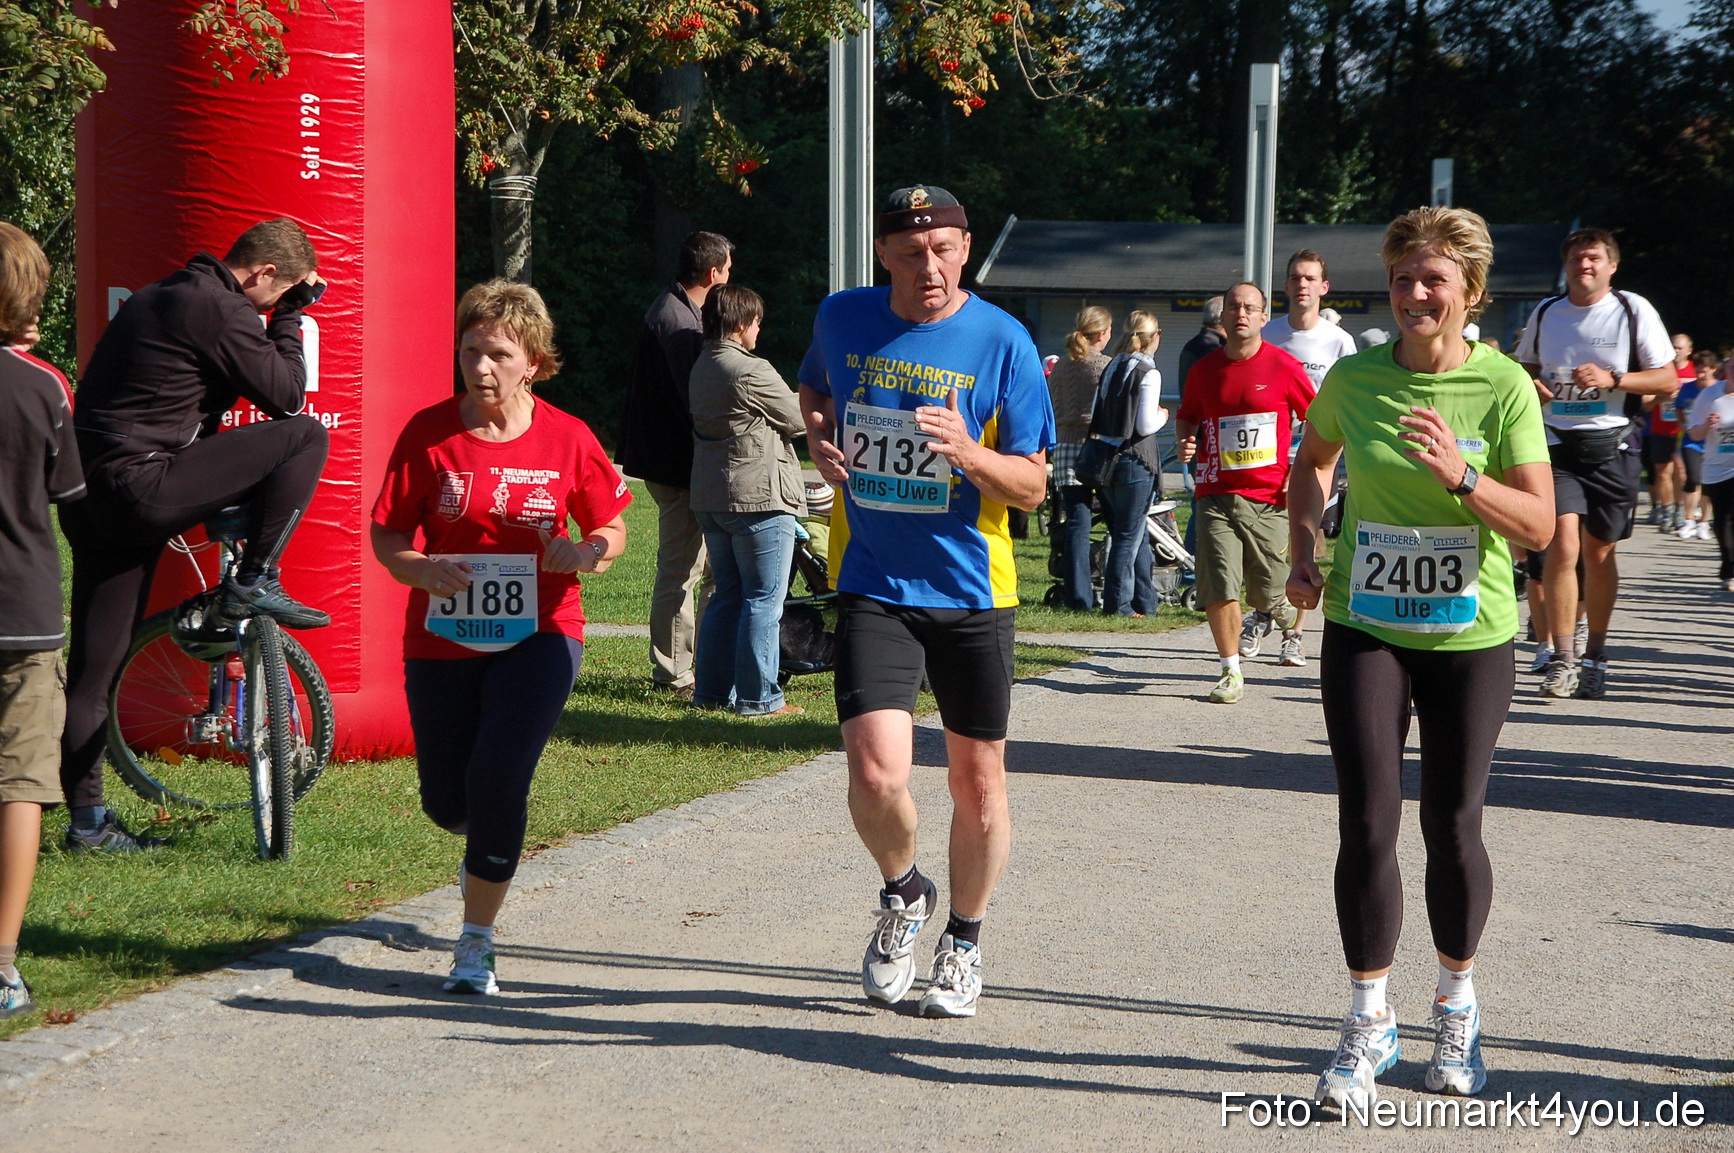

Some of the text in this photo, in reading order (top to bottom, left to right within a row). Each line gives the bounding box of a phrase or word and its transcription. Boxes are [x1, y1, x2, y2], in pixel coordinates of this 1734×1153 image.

[300, 93, 320, 179] Seit 1929
[846, 354, 976, 389] 10. NEUMARKTER
[858, 371, 950, 400] STADTLAUF
[857, 413, 904, 428] PFLEIDERER
[1237, 428, 1260, 449] 97
[853, 432, 938, 479] 2132
[1236, 450, 1264, 462] Silvio
[490, 467, 560, 479] 11. NEUMARKTER
[501, 475, 550, 485] STADTLAUF
[851, 472, 938, 501] Jens-Uwe
[1370, 532, 1420, 546] PFLEIDERER
[1364, 551, 1463, 595] 2403
[1394, 598, 1431, 618] Ute
[456, 619, 505, 638] Stilla
